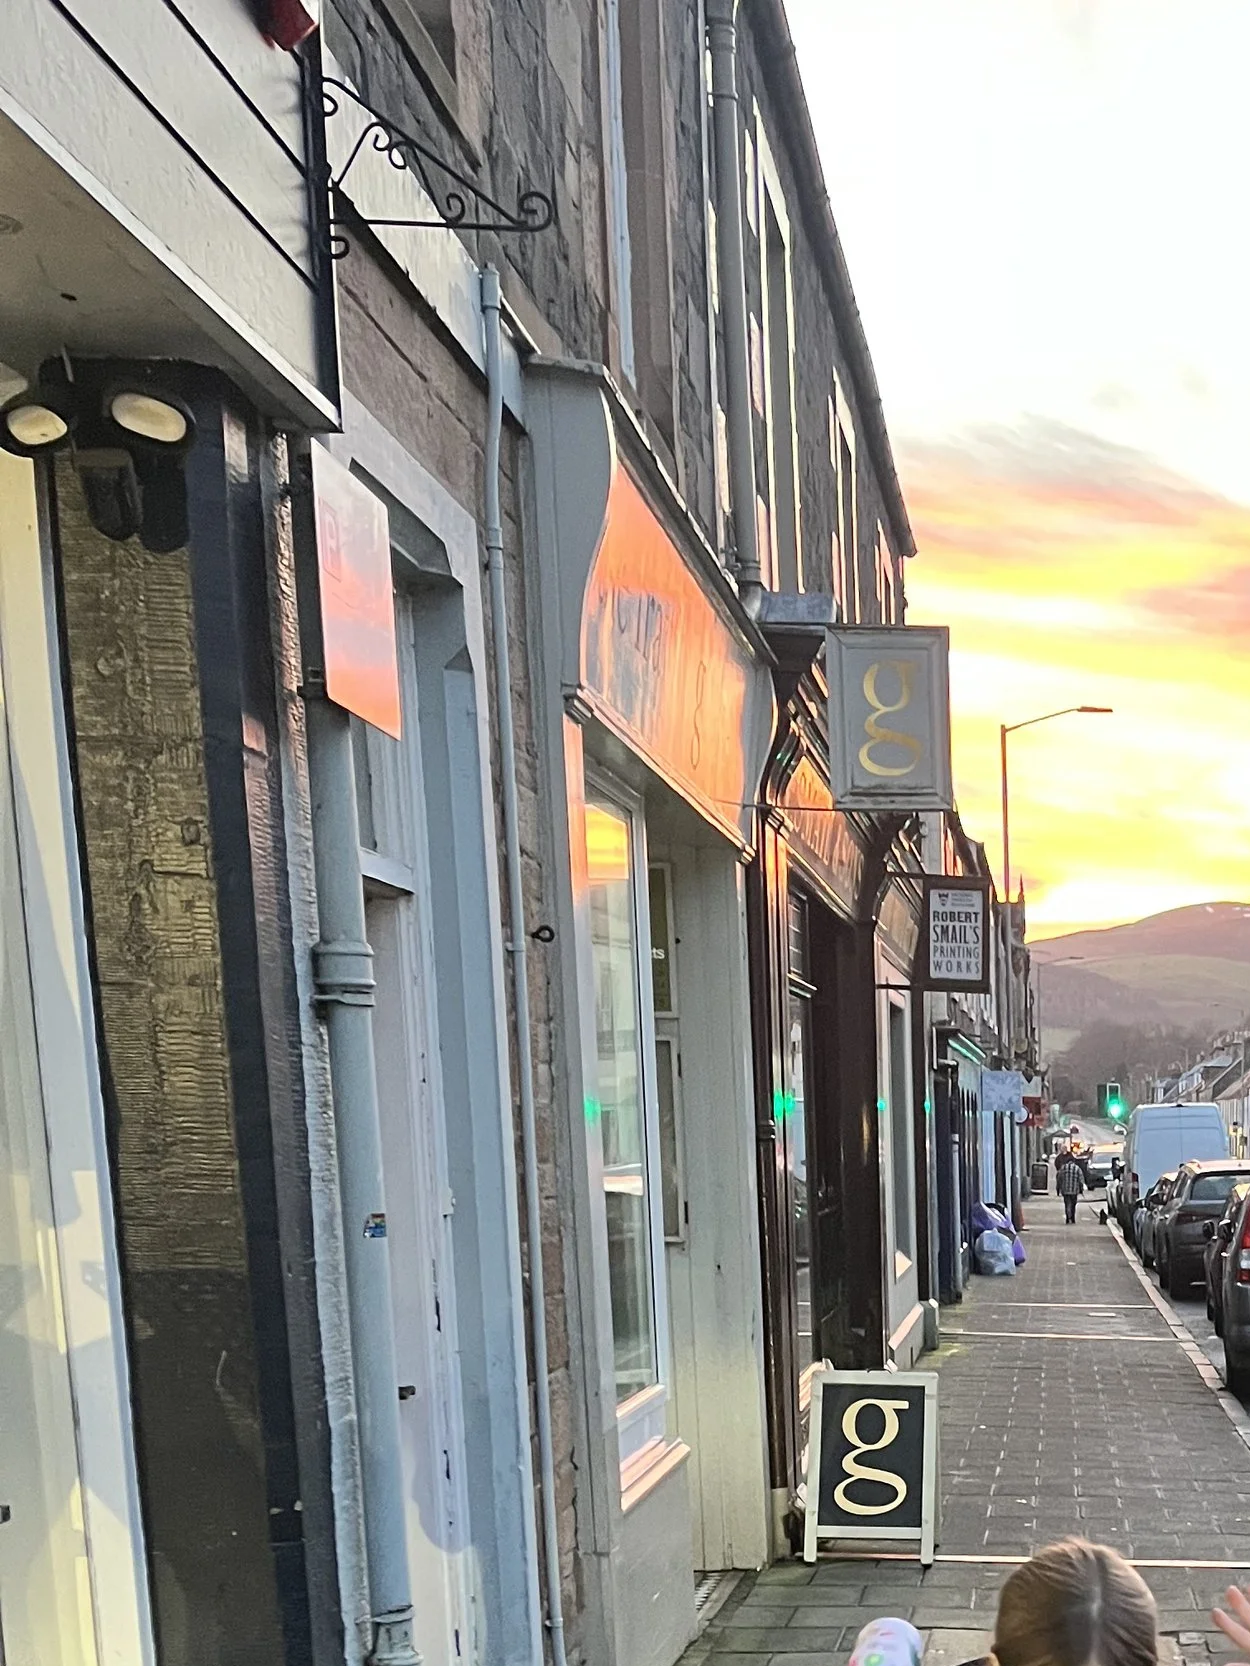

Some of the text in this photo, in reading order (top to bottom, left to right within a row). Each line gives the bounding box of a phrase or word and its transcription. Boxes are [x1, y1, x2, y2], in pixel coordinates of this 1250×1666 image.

[858, 661, 921, 776] g
[933, 911, 980, 923] ROBERT
[933, 924, 980, 944] SMAIL'S
[933, 944, 980, 959] PRINTING
[933, 960, 980, 974] WORKS
[834, 1398, 909, 1516] g
